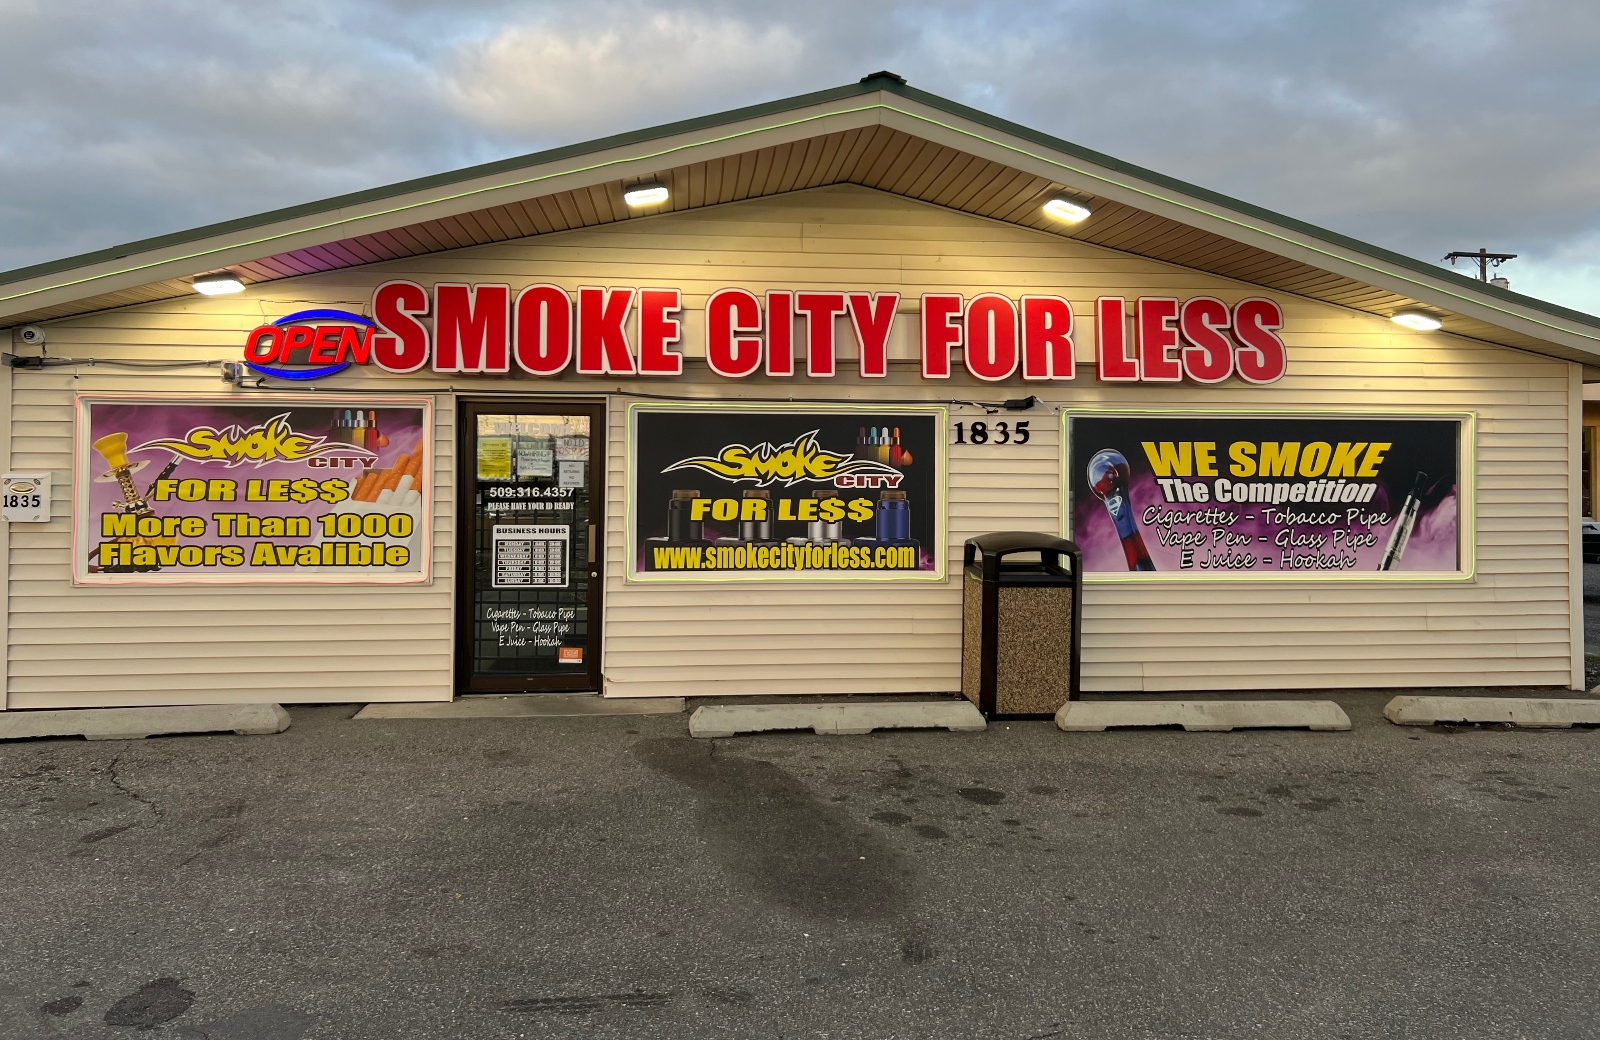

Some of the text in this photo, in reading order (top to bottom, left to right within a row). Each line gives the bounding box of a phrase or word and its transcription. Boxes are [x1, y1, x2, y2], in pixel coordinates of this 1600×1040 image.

[244, 325, 376, 364] OPEN
[371, 279, 1288, 386] SMOKE CITY FOR LESS
[184, 412, 328, 468] SMOKE
[954, 421, 1031, 445] 1835
[307, 456, 379, 469] CITY
[716, 429, 855, 487] SMOKE
[1141, 441, 1392, 478] WE SMOKE
[153, 477, 350, 504] FOR LE$$
[833, 473, 904, 489] CITY
[1157, 478, 1379, 506] The Competition
[3, 495, 41, 508] 1835
[487, 502, 574, 510] PLEASE HAVE YOUR ID READY
[690, 496, 874, 523] FOR LE$$
[101, 512, 414, 538] More Than 1000
[1143, 506, 1239, 530] Cigarettes
[1261, 507, 1342, 526] Tobacco
[1346, 509, 1392, 532] Pipe
[1157, 529, 1207, 550] Vape
[1212, 529, 1252, 547] Pen
[1275, 529, 1327, 548] Glass
[1333, 530, 1379, 551] Pipe
[98, 541, 410, 567] Flavors Avalible
[653, 543, 915, 571] www.smokecityforless.com
[1180, 551, 1194, 568] E
[1200, 551, 1257, 569] Juice
[1279, 551, 1357, 569] Hookah
[486, 607, 521, 621] Cigarettes
[528, 607, 557, 620] Tobacco
[558, 607, 575, 622] Pipe
[491, 621, 510, 635] Vape
[510, 621, 526, 633] Pen
[532, 621, 553, 634] Glass
[553, 621, 570, 635] Pipe
[499, 635, 505, 646] E
[506, 635, 527, 646] Juice
[534, 635, 563, 647] Hookah
